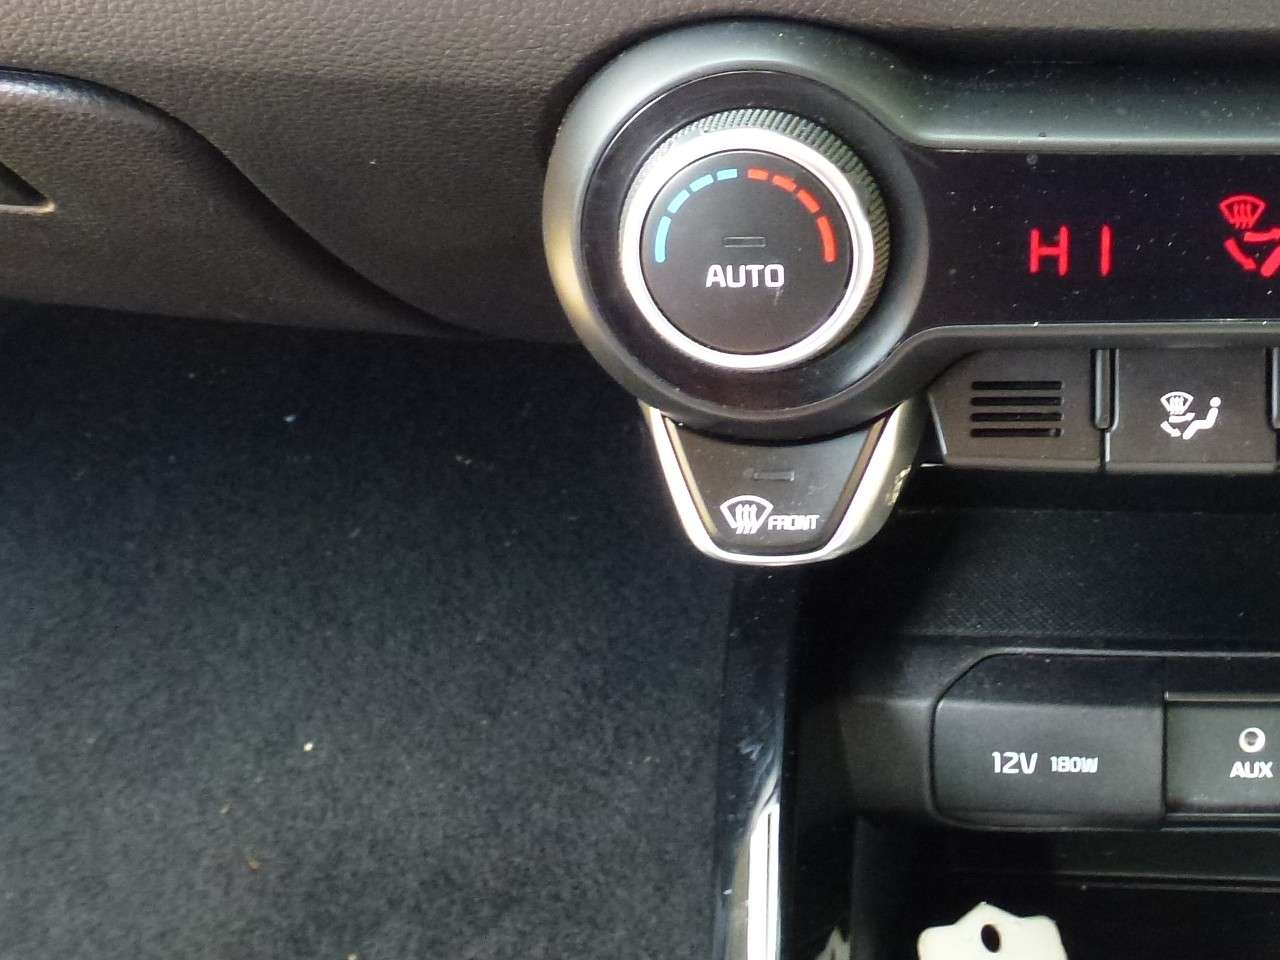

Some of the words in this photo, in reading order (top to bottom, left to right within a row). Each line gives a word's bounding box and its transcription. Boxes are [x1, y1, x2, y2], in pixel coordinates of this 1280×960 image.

[705, 263, 785, 289] AUTO
[767, 514, 821, 531] FRONT
[991, 751, 1038, 775] 12V
[1049, 755, 1099, 774] 180W
[1229, 761, 1274, 779] AUX
